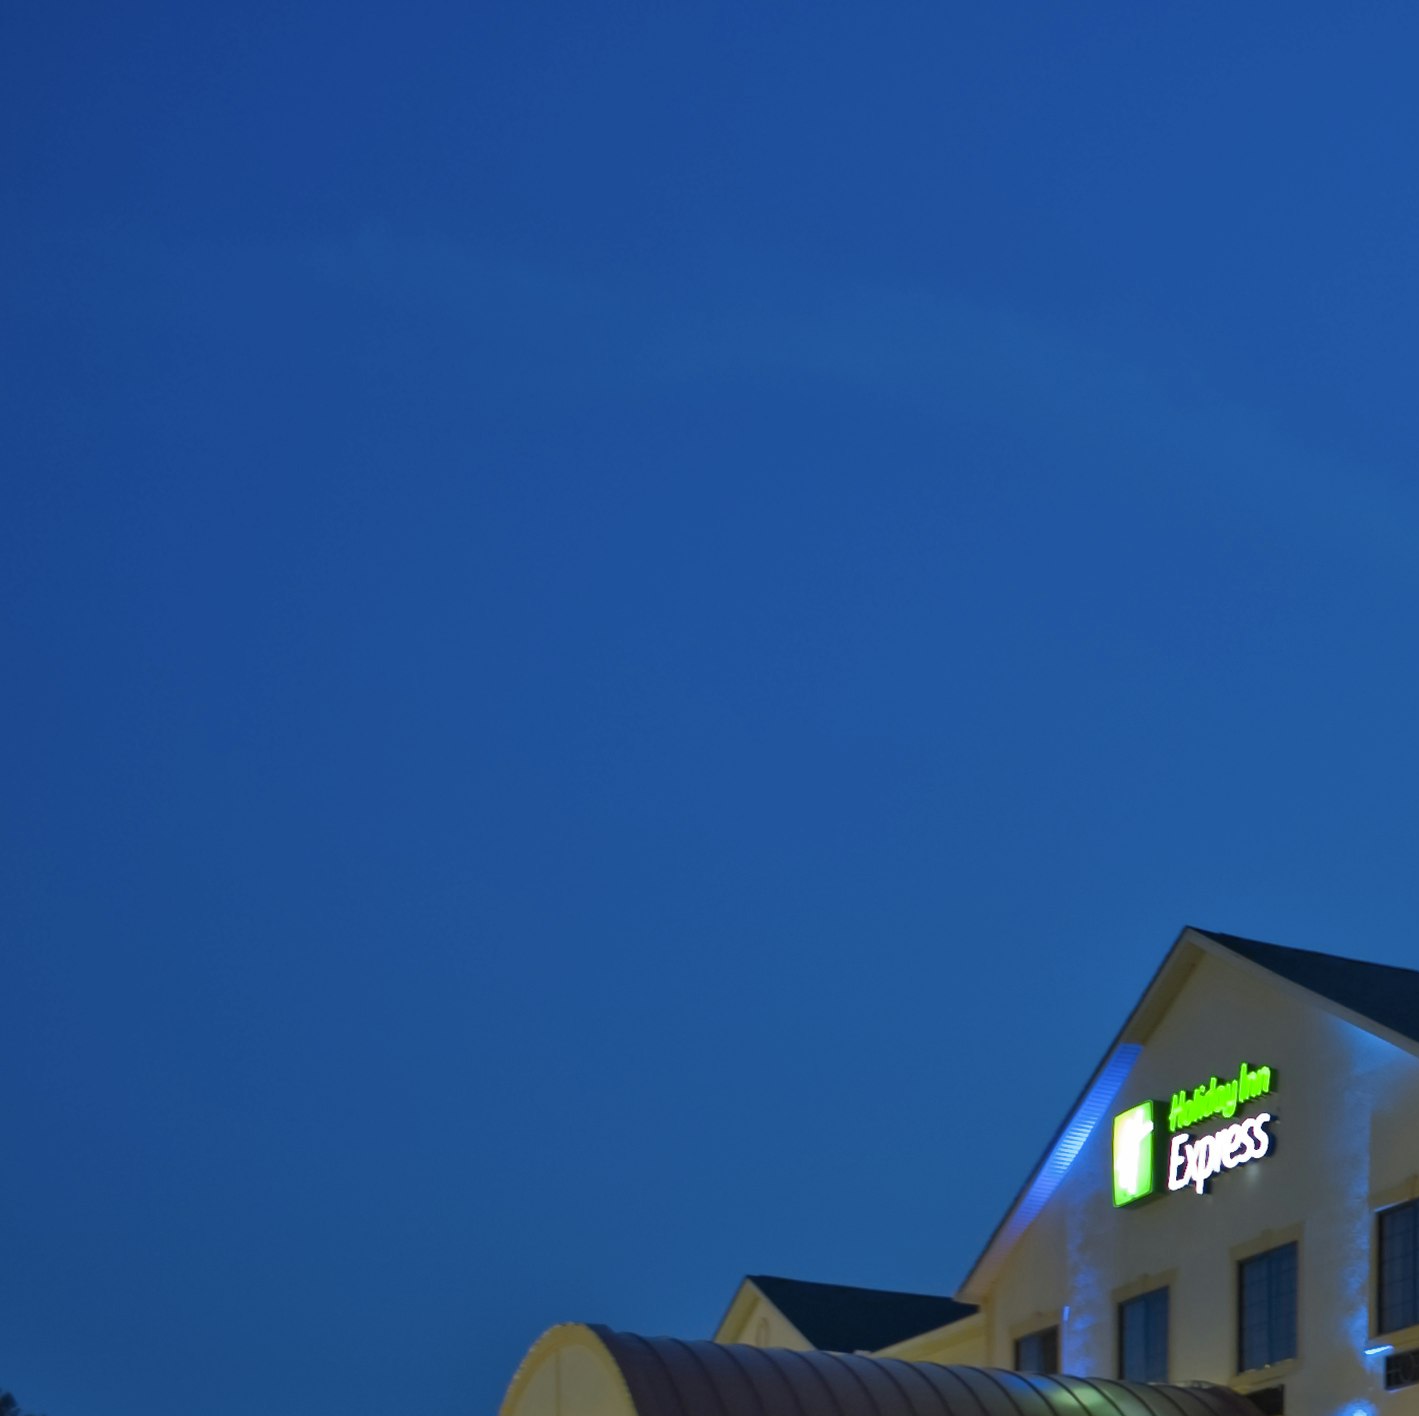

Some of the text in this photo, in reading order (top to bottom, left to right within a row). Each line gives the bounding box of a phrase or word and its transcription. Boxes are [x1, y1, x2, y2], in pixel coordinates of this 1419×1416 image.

[1169, 1063, 1271, 1132] Holiday Inn
[1168, 1113, 1271, 1194] Express
